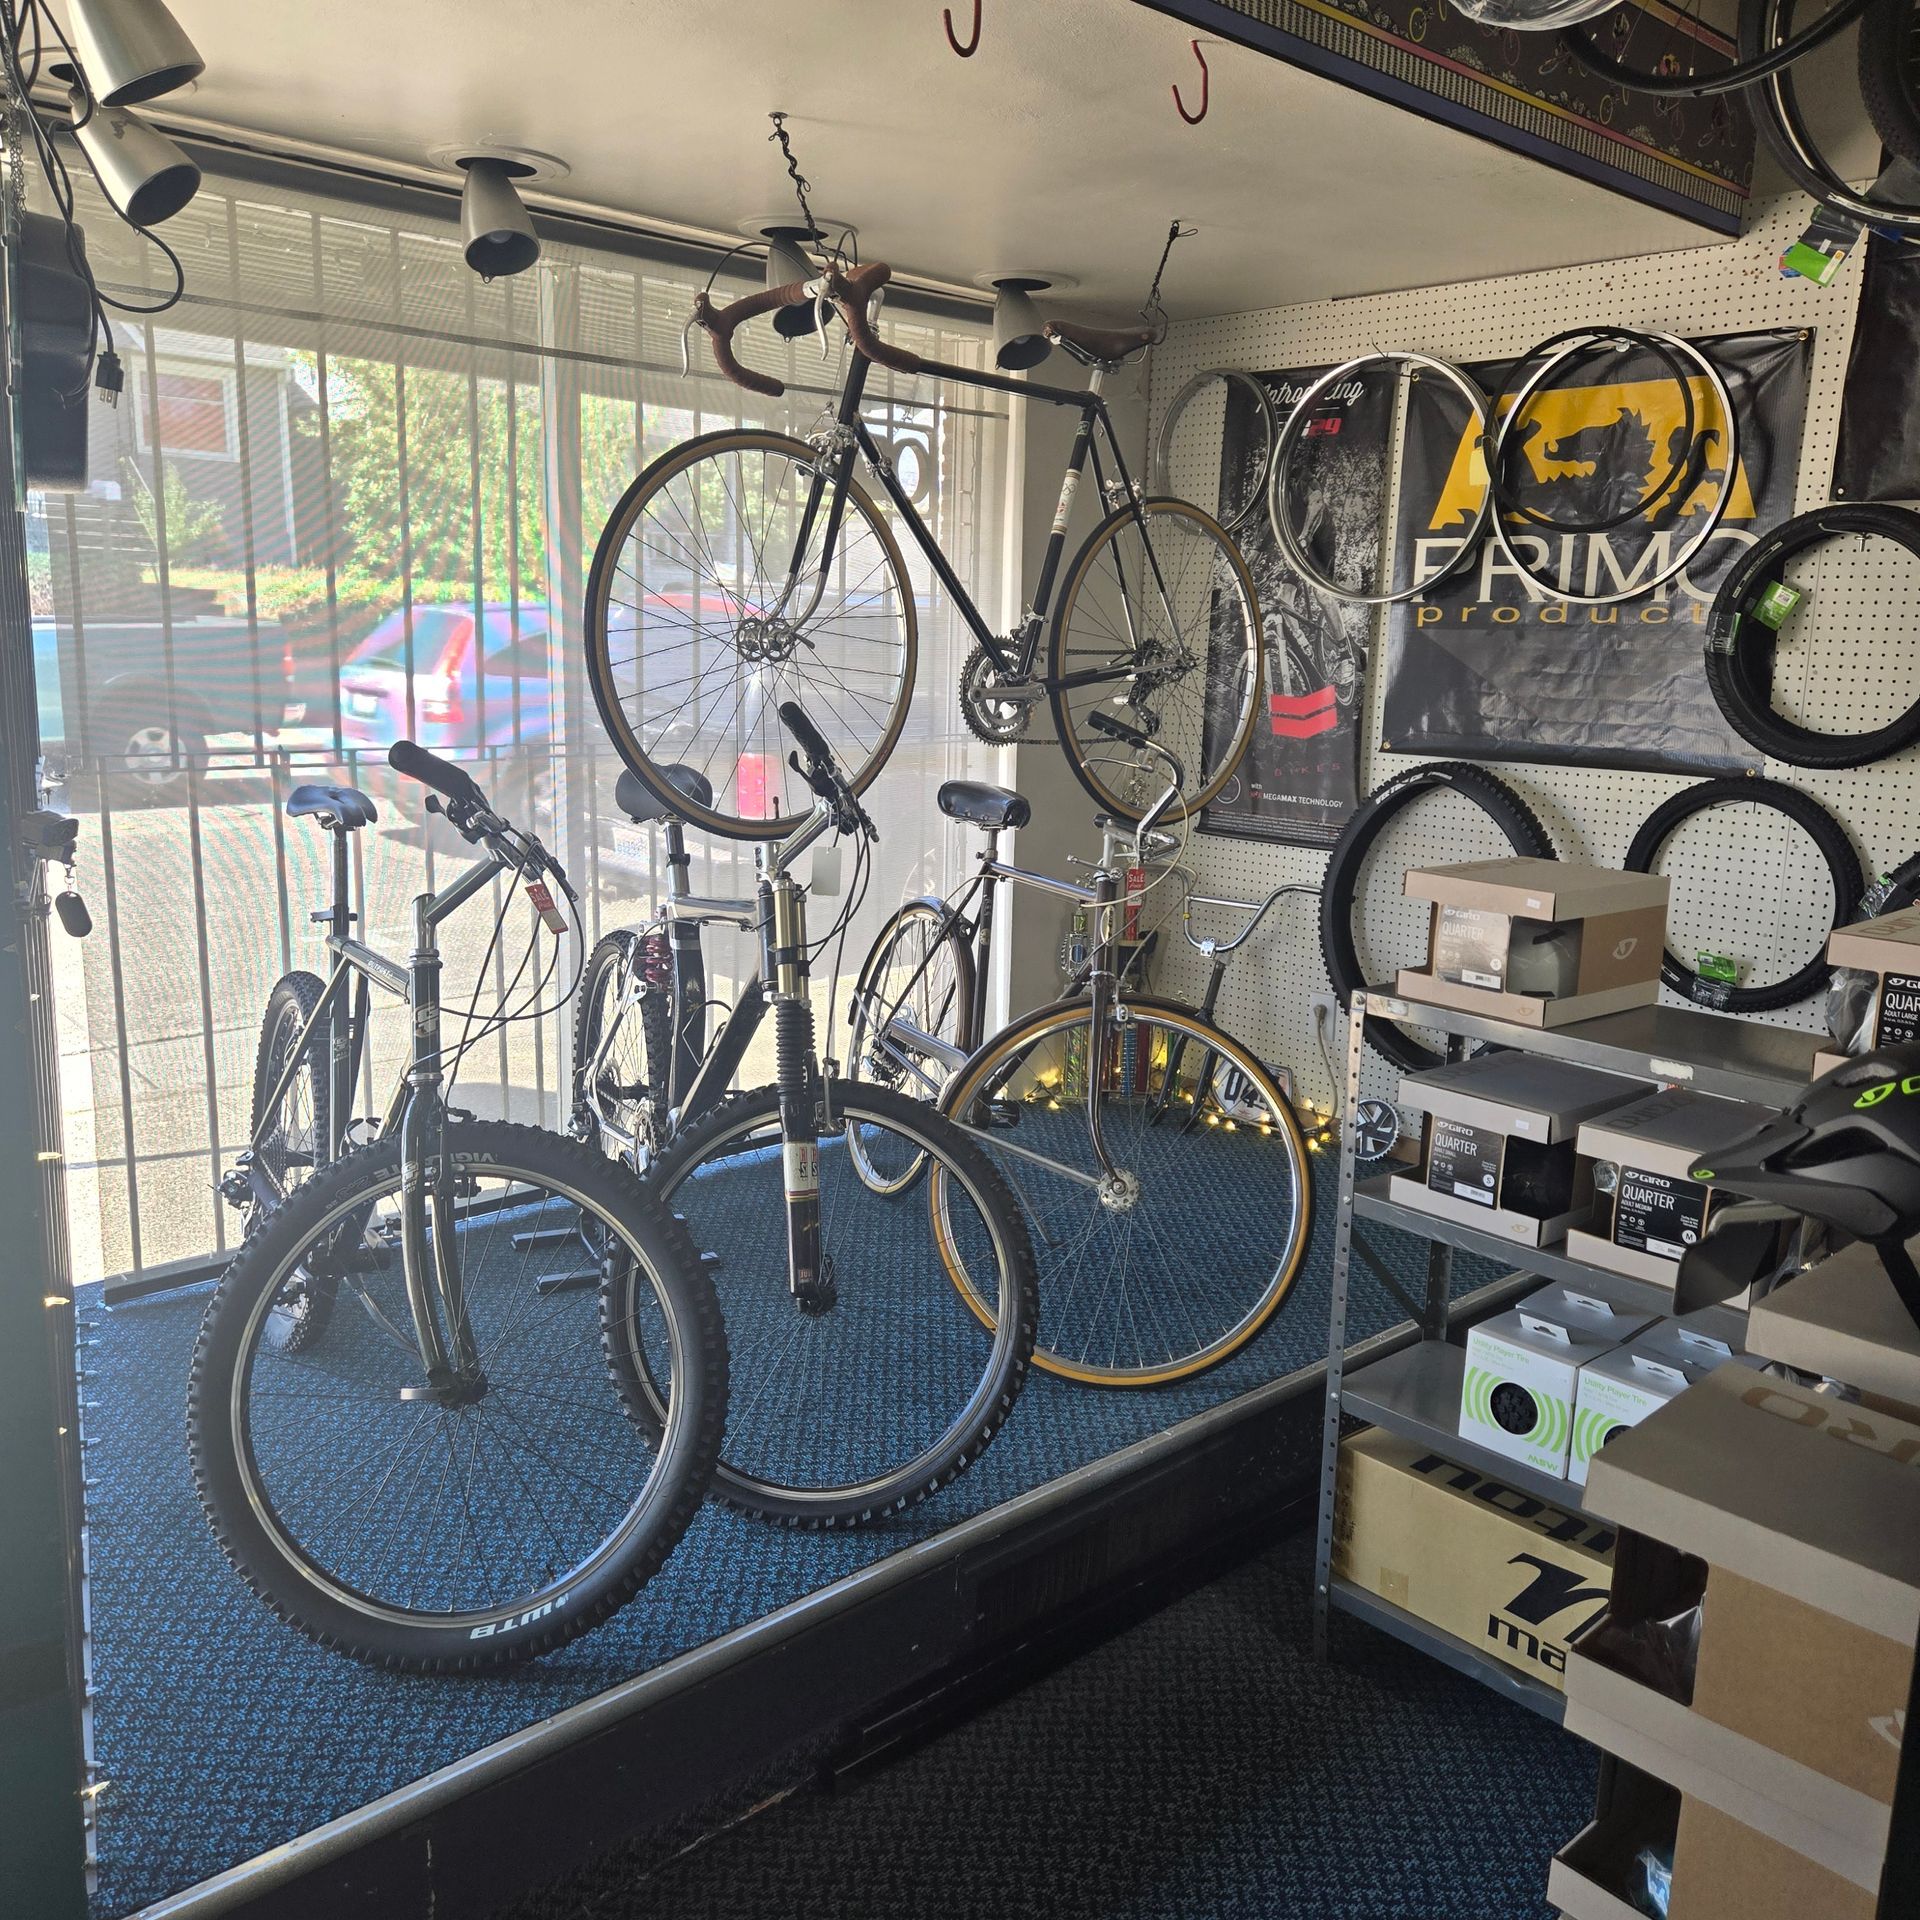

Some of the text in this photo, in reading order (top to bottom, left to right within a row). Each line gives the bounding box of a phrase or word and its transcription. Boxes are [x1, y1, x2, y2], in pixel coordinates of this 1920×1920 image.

[1417, 602, 1708, 628] product
[1298, 796, 1343, 808] TECHNOLOGY
[1129, 874, 1144, 882] SALE
[1442, 921, 1484, 941] QUARTER
[1885, 992, 1920, 1013] QUAR
[1884, 1009, 1918, 1021] ADULT LARGE
[1448, 1125, 1473, 1137] GIRO
[1435, 1132, 1477, 1157] QUARTER
[1639, 1175, 1670, 1188] GIRO
[1620, 1199, 1634, 1208] ADULT
[1634, 1202, 1653, 1213] MEDIUM
[1622, 1184, 1675, 1210] QUARTER
[1607, 1384, 1632, 1400] Player
[1632, 1393, 1648, 1407] Tire
[1527, 1454, 1559, 1472] MSW
[470, 1601, 552, 1640] WTB
